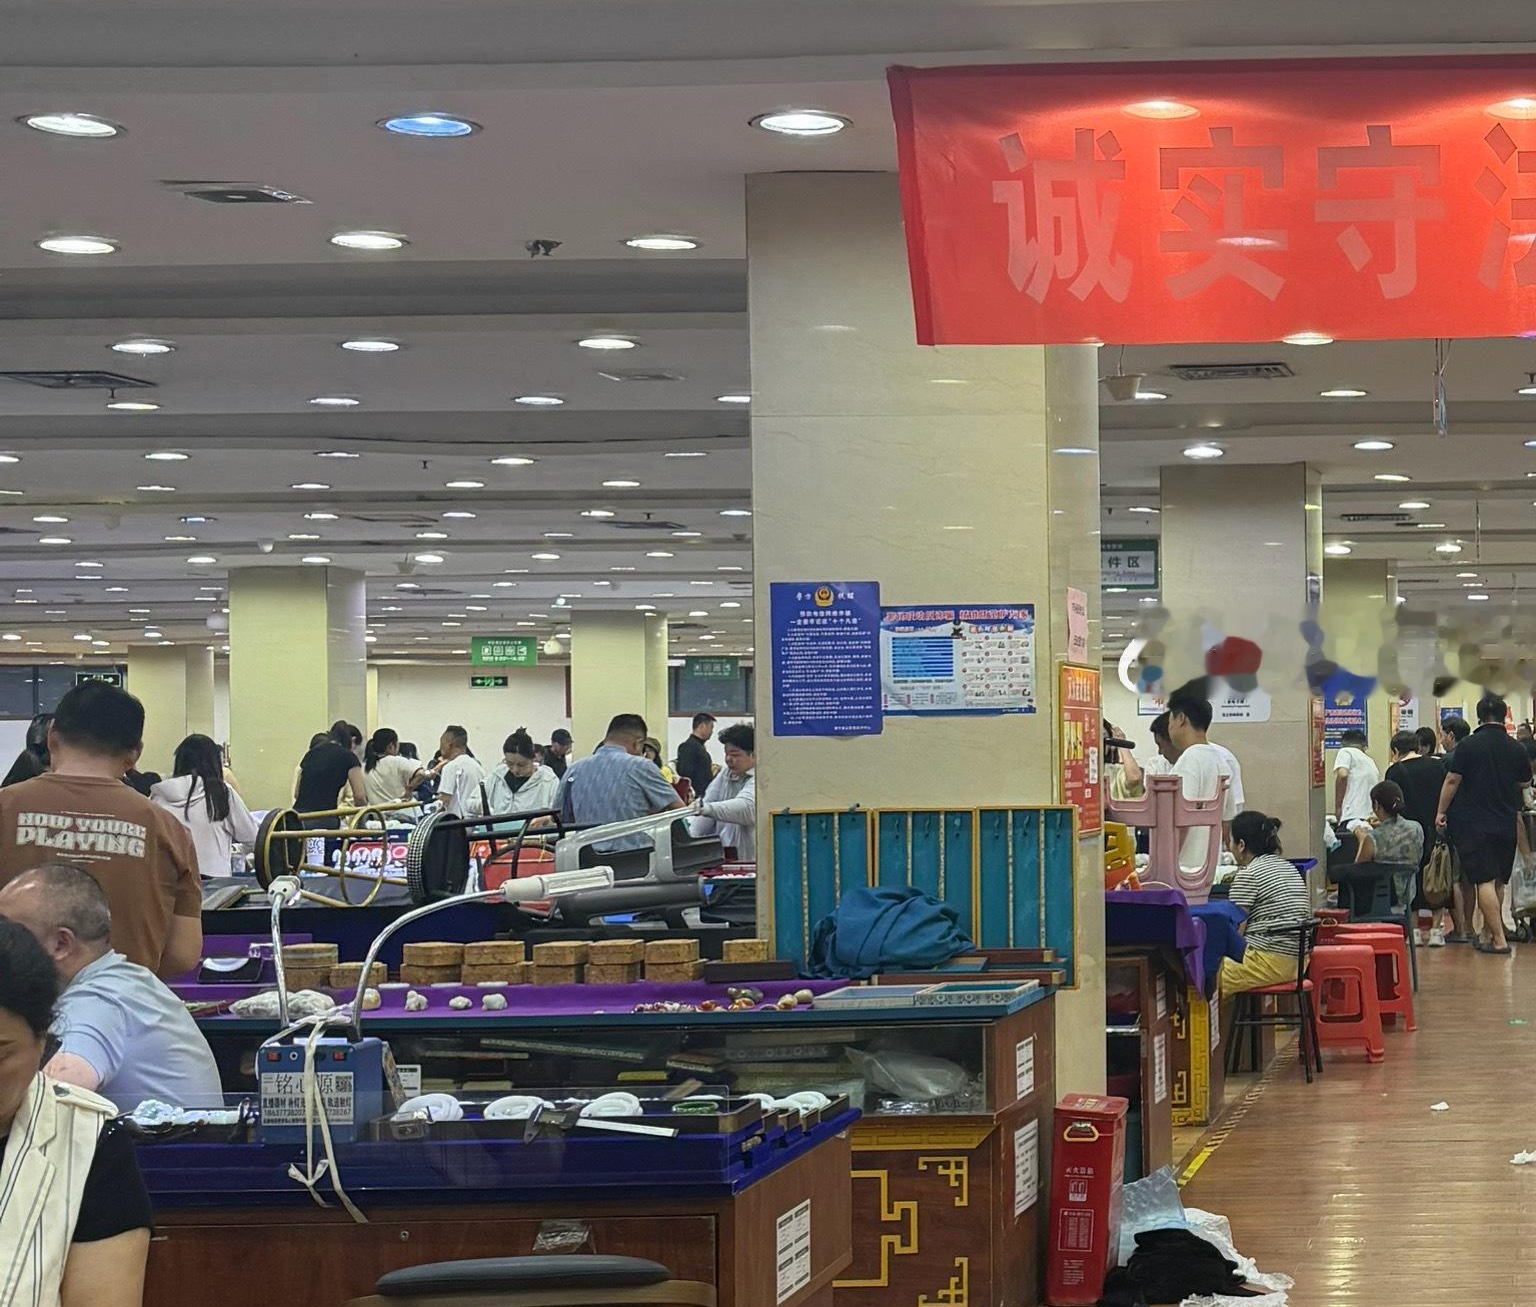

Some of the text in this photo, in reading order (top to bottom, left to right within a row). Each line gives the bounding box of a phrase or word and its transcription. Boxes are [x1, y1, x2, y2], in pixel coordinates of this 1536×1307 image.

[1101, 556, 1140, 568] 件区
[18, 813, 73, 830] NOW
[16, 826, 145, 858] PLAYING
